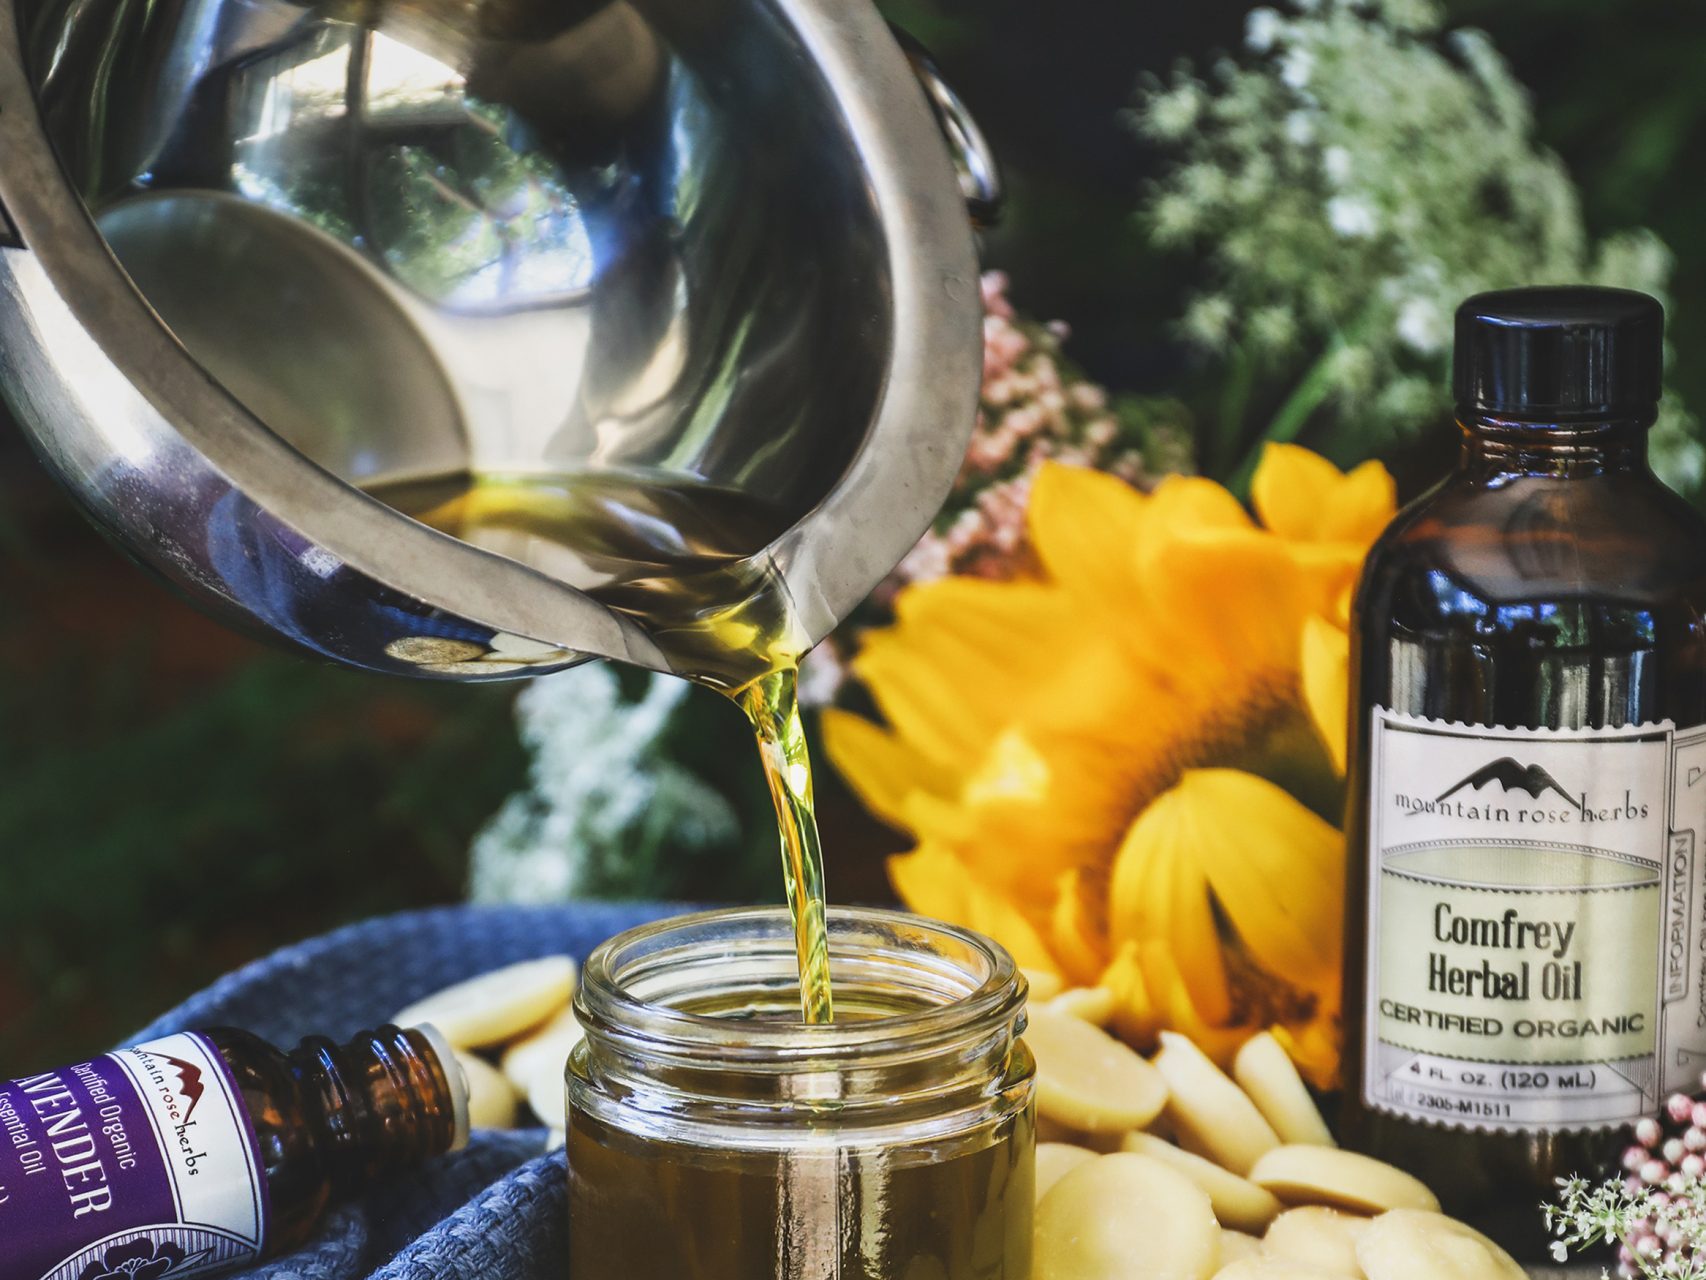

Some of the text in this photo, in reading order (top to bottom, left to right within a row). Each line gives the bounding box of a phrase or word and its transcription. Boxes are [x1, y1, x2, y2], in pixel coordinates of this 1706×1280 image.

[1395, 789, 1650, 824] mountain rose herbs
[1434, 901, 1577, 959] Comfrey
[1669, 837, 1688, 995] INFORMATION
[1428, 951, 1582, 1001] Herbal Oil
[1379, 998, 1645, 1038] CERTIFIED ORGANIC
[1409, 1062, 1421, 1075] 4
[1501, 1071, 1550, 1091] (120
[70, 1062, 137, 1171] Certified Organic
[159, 1086, 181, 1121] rose
[174, 1119, 208, 1177] herbs
[10, 1071, 113, 1220] AVENDER
[19, 1149, 47, 1176] Oil
